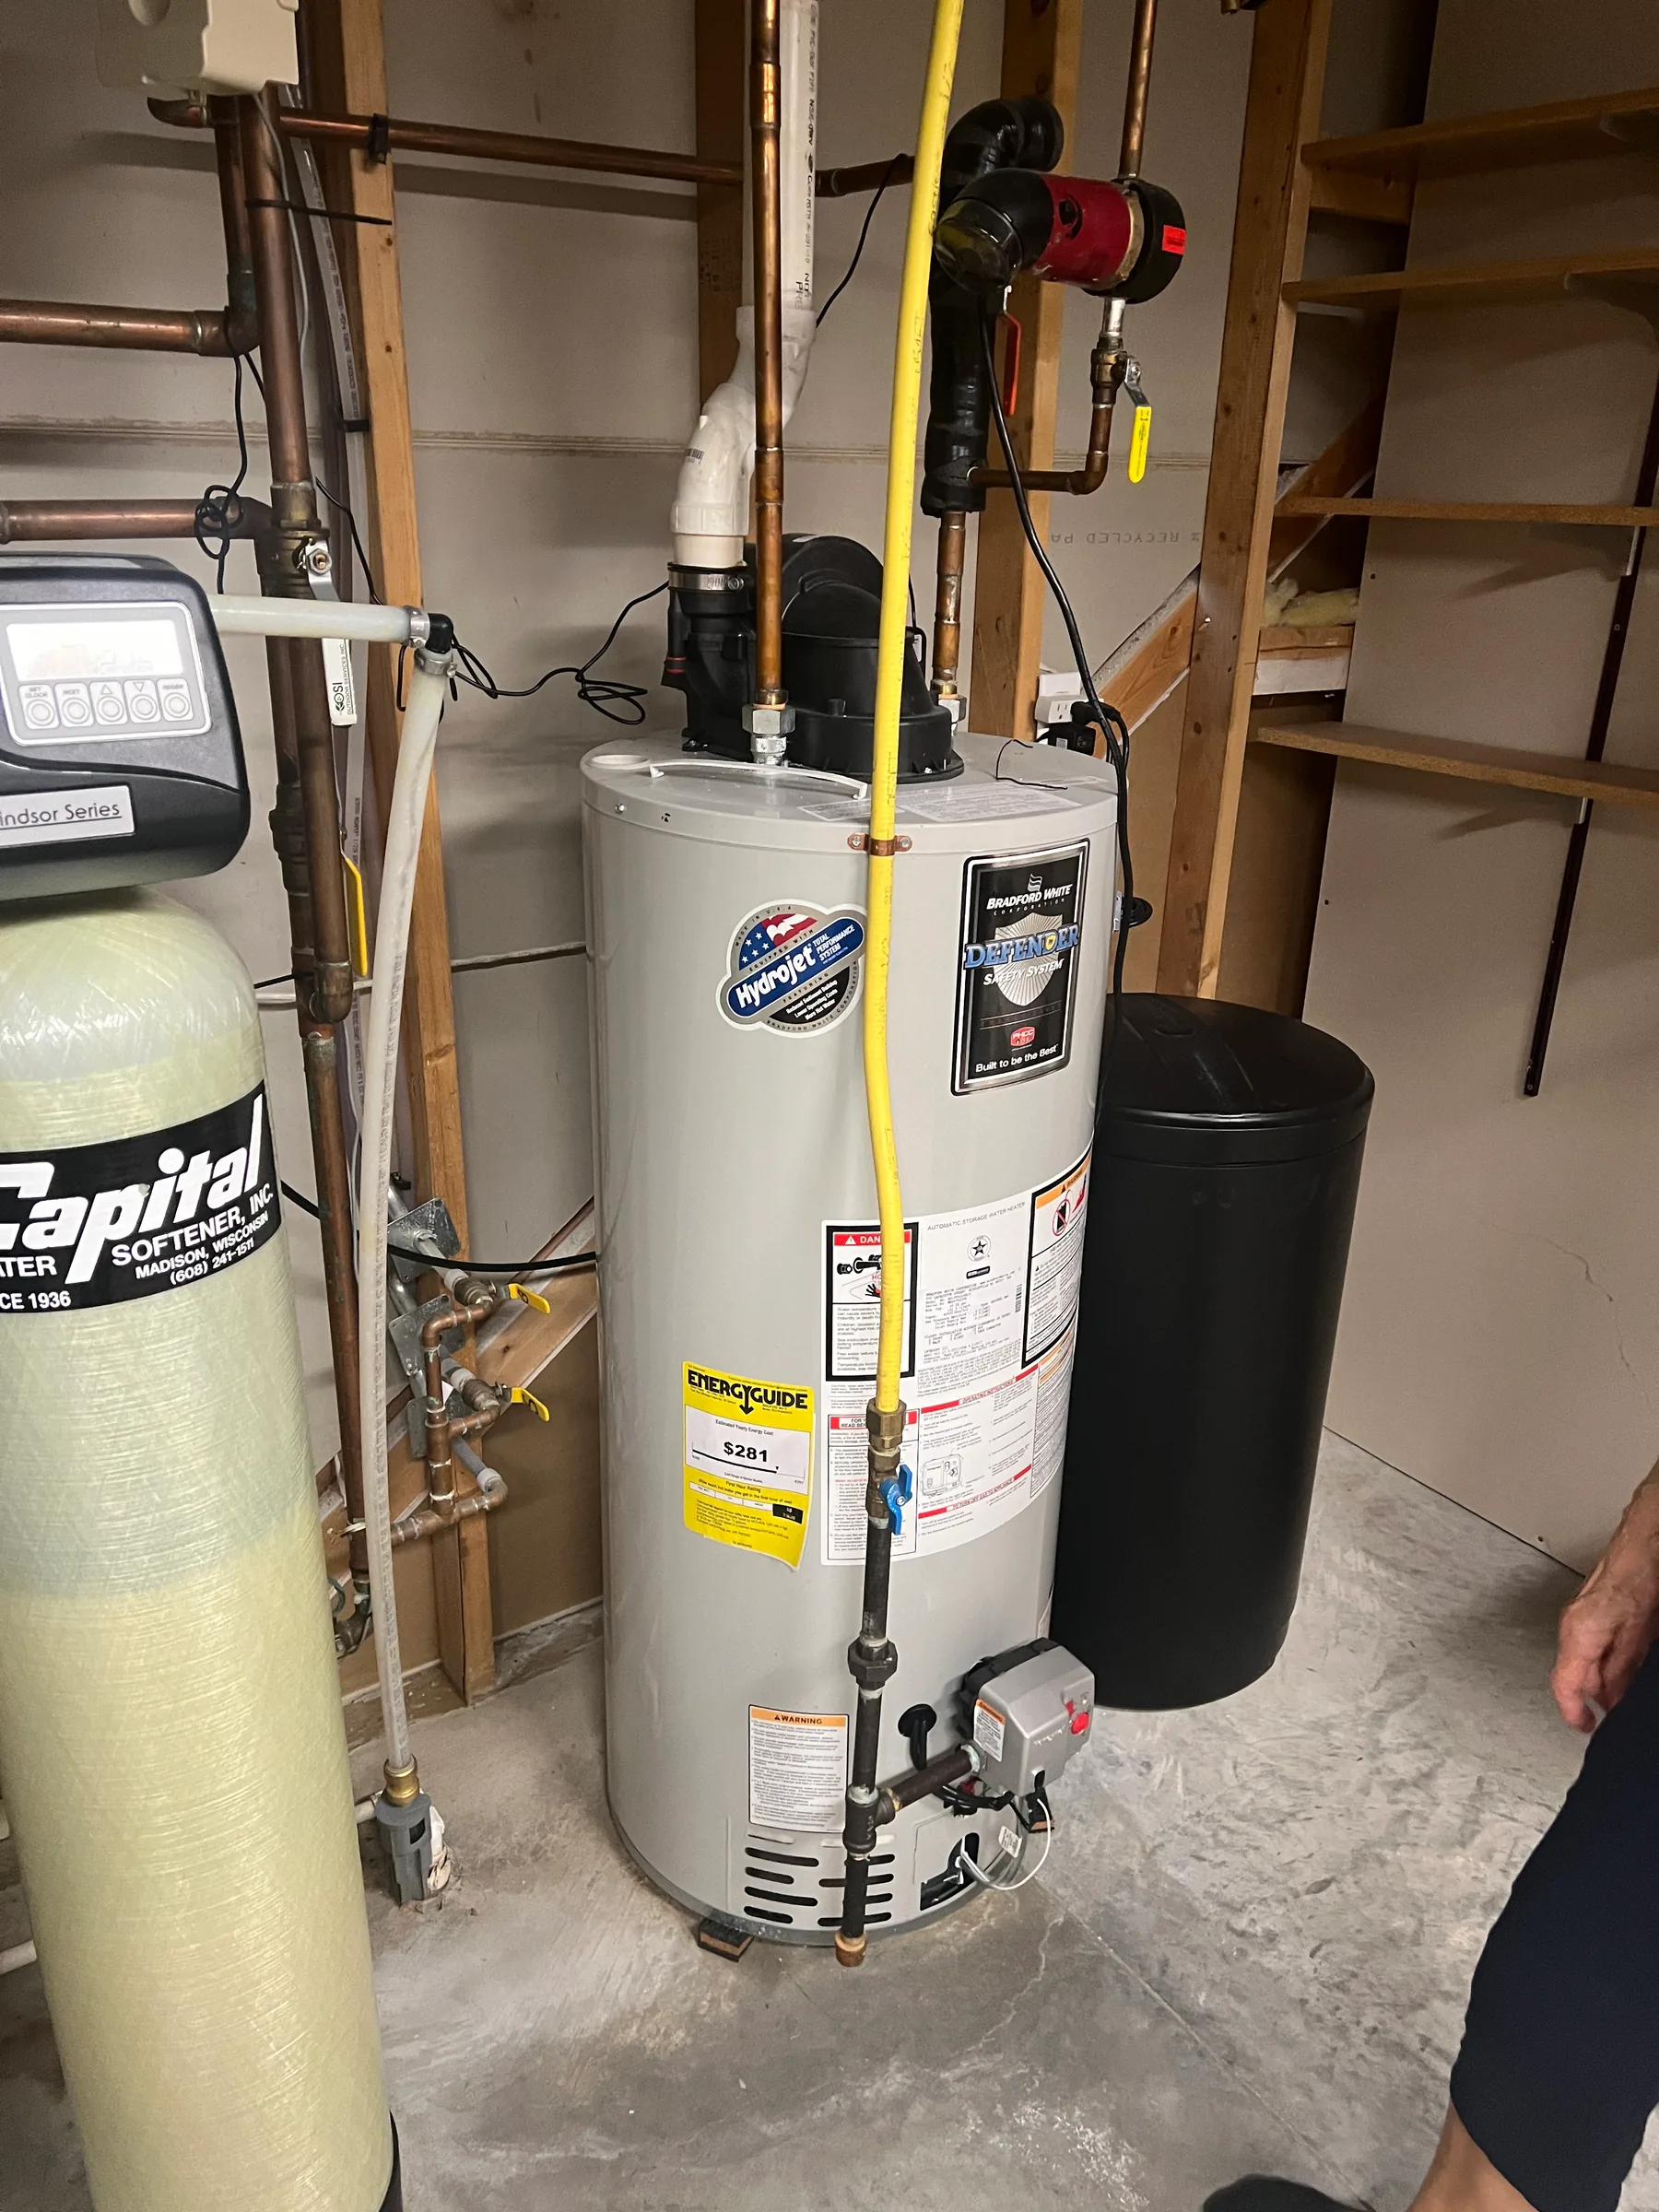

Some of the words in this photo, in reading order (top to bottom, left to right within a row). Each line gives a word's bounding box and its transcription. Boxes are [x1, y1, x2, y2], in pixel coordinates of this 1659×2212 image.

[1086, 531, 1179, 544] RECYCLED
[65, 803, 120, 819] Series
[986, 891, 1042, 910] BRADFORD
[1043, 884, 1073, 900] WHITE
[794, 929, 813, 944] WITH
[812, 933, 830, 947] TOTAL
[816, 924, 855, 954] PERFORMANCE
[964, 923, 1079, 970] DEFENDER
[819, 943, 841, 960] SYSTEM
[735, 944, 816, 1009] Hydrojet
[982, 968, 1025, 985] SAFETY
[1025, 959, 1065, 977] SYSTEM
[975, 1061, 997, 1072] Built
[999, 1060, 1008, 1068] to
[1010, 1056, 1022, 1065] be
[1024, 1053, 1038, 1062] the
[112, 1206, 246, 1266] SOFTENER,
[249, 1183, 274, 1215] INC.
[927, 1220, 961, 1230] AUTOMATIC
[962, 1214, 988, 1226] STORAGE
[988, 1208, 1006, 1218] WATER
[1007, 1201, 1026, 1212] HEATER
[135, 1249, 209, 1278] MADISON,
[212, 1210, 269, 1253] WISCONSIN
[170, 1263, 208, 1285] (608)
[212, 1237, 254, 1269] 241-1511
[29, 1290, 71, 1309] 1936
[688, 1369, 808, 1413] ENERGYGUIDE
[715, 1419, 735, 1429] Estimated
[748, 1427, 762, 1435] Energy
[724, 1441, 768, 1463] $281
[781, 1714, 823, 1724] WARNING
